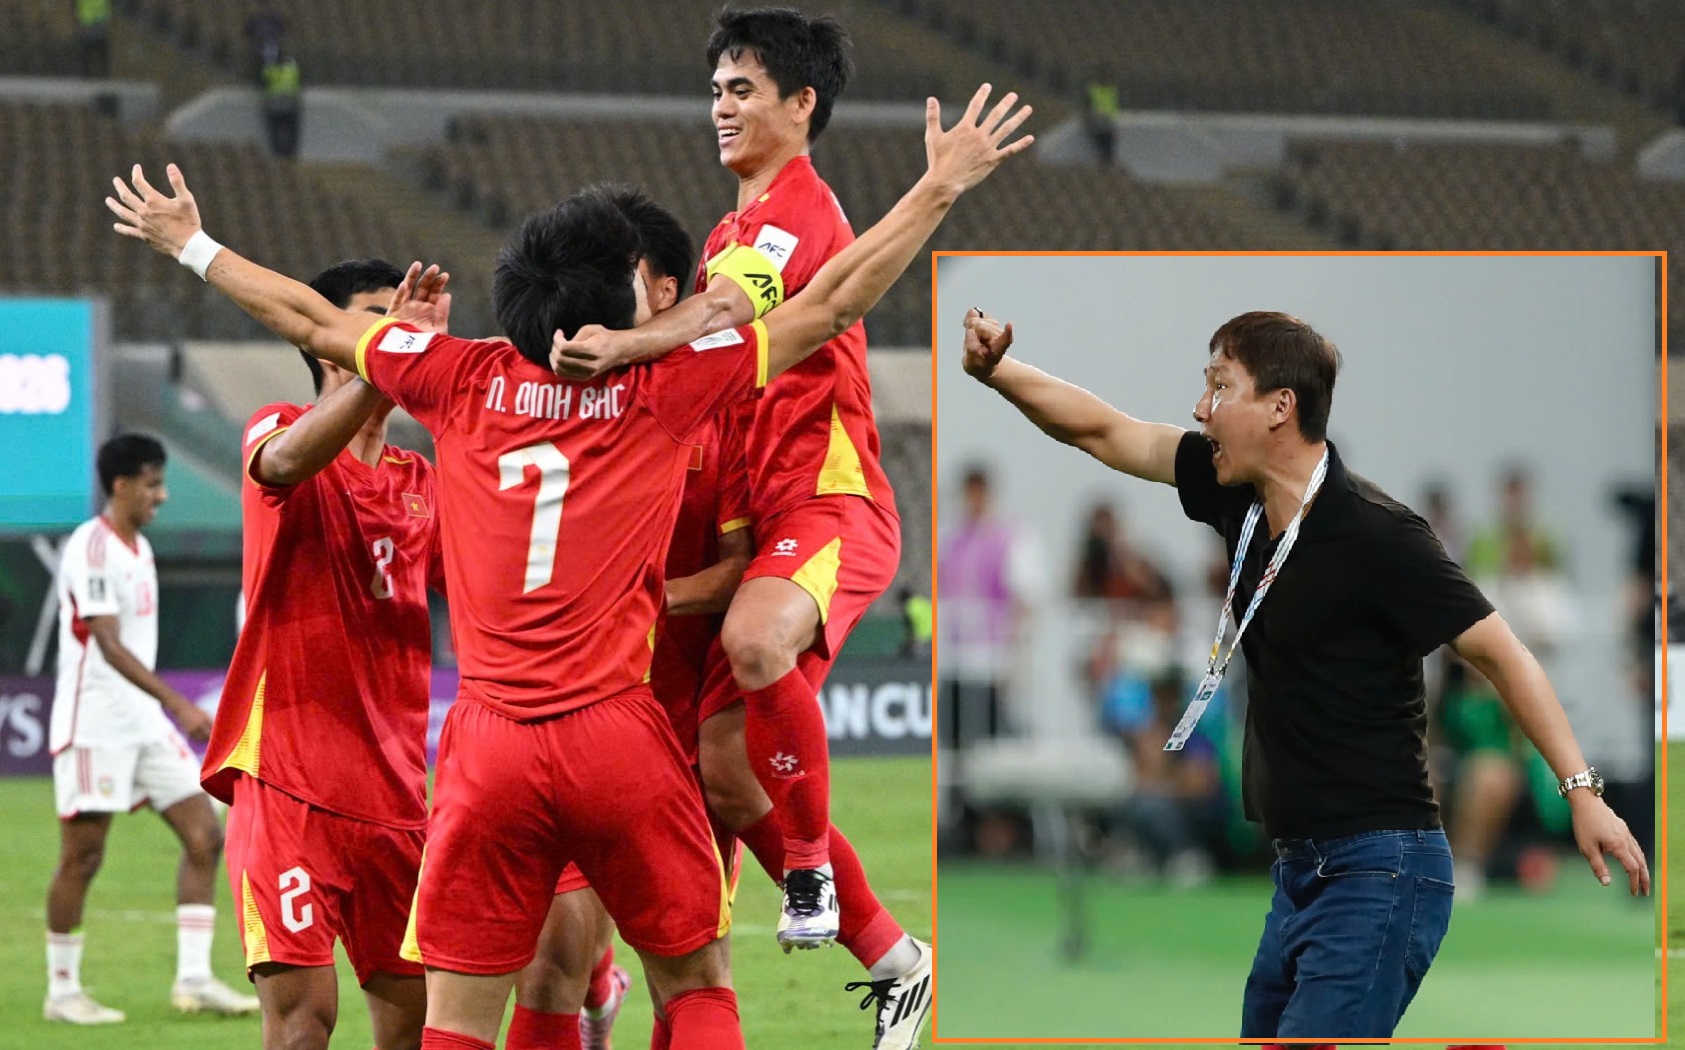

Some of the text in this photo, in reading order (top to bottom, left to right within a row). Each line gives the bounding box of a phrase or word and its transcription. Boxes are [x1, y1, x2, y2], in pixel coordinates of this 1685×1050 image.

[758, 242, 786, 258] AFC
[498, 441, 570, 595] 7
[370, 536, 394, 600] 2
[0, 693, 44, 758] S
[818, 682, 932, 739] NCU
[279, 866, 314, 933] 2
